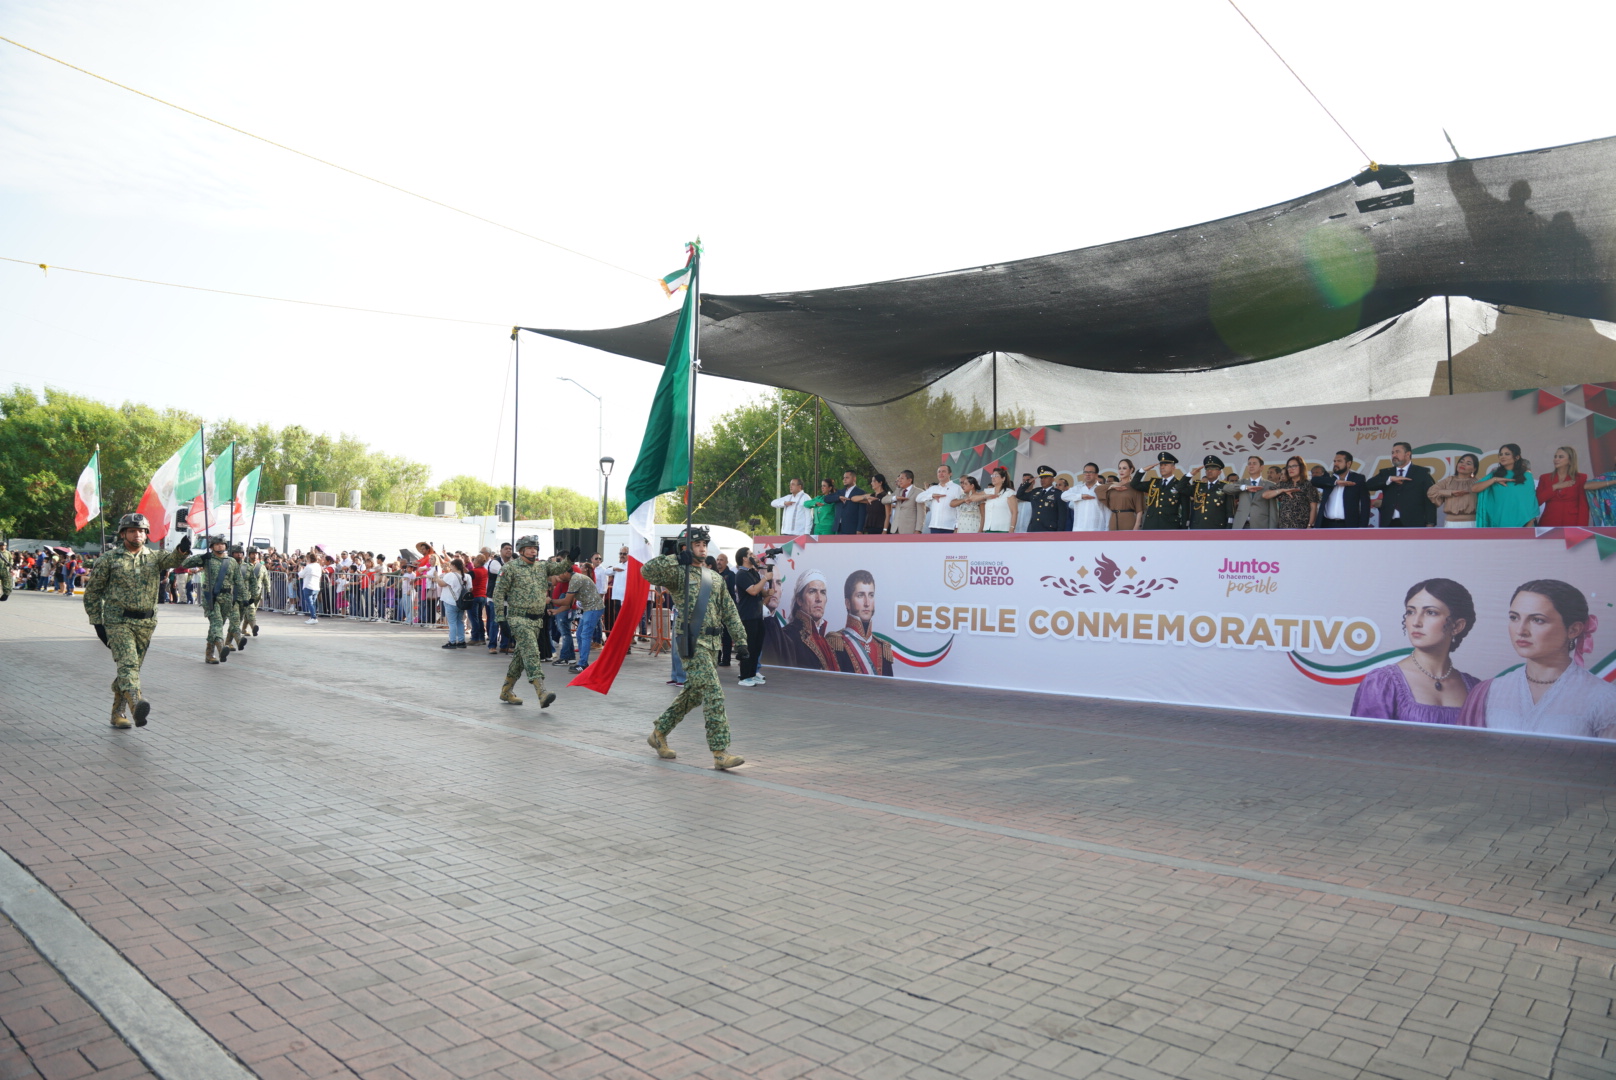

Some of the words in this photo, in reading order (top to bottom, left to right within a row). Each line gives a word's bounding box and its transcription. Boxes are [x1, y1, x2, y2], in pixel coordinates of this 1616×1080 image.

[1349, 414, 1399, 427] Juntos
[1143, 435, 1177, 444] NUEVO
[1356, 426, 1398, 445] posible
[1143, 442, 1181, 451] LAREDO
[970, 566, 1010, 576] NUEVO
[1218, 558, 1280, 573] Juntos
[970, 576, 1014, 586] LAREDO
[1226, 576, 1278, 597] posible
[896, 604, 1017, 633] DESFILE
[1028, 609, 1376, 651] CONMEMORATIVO
